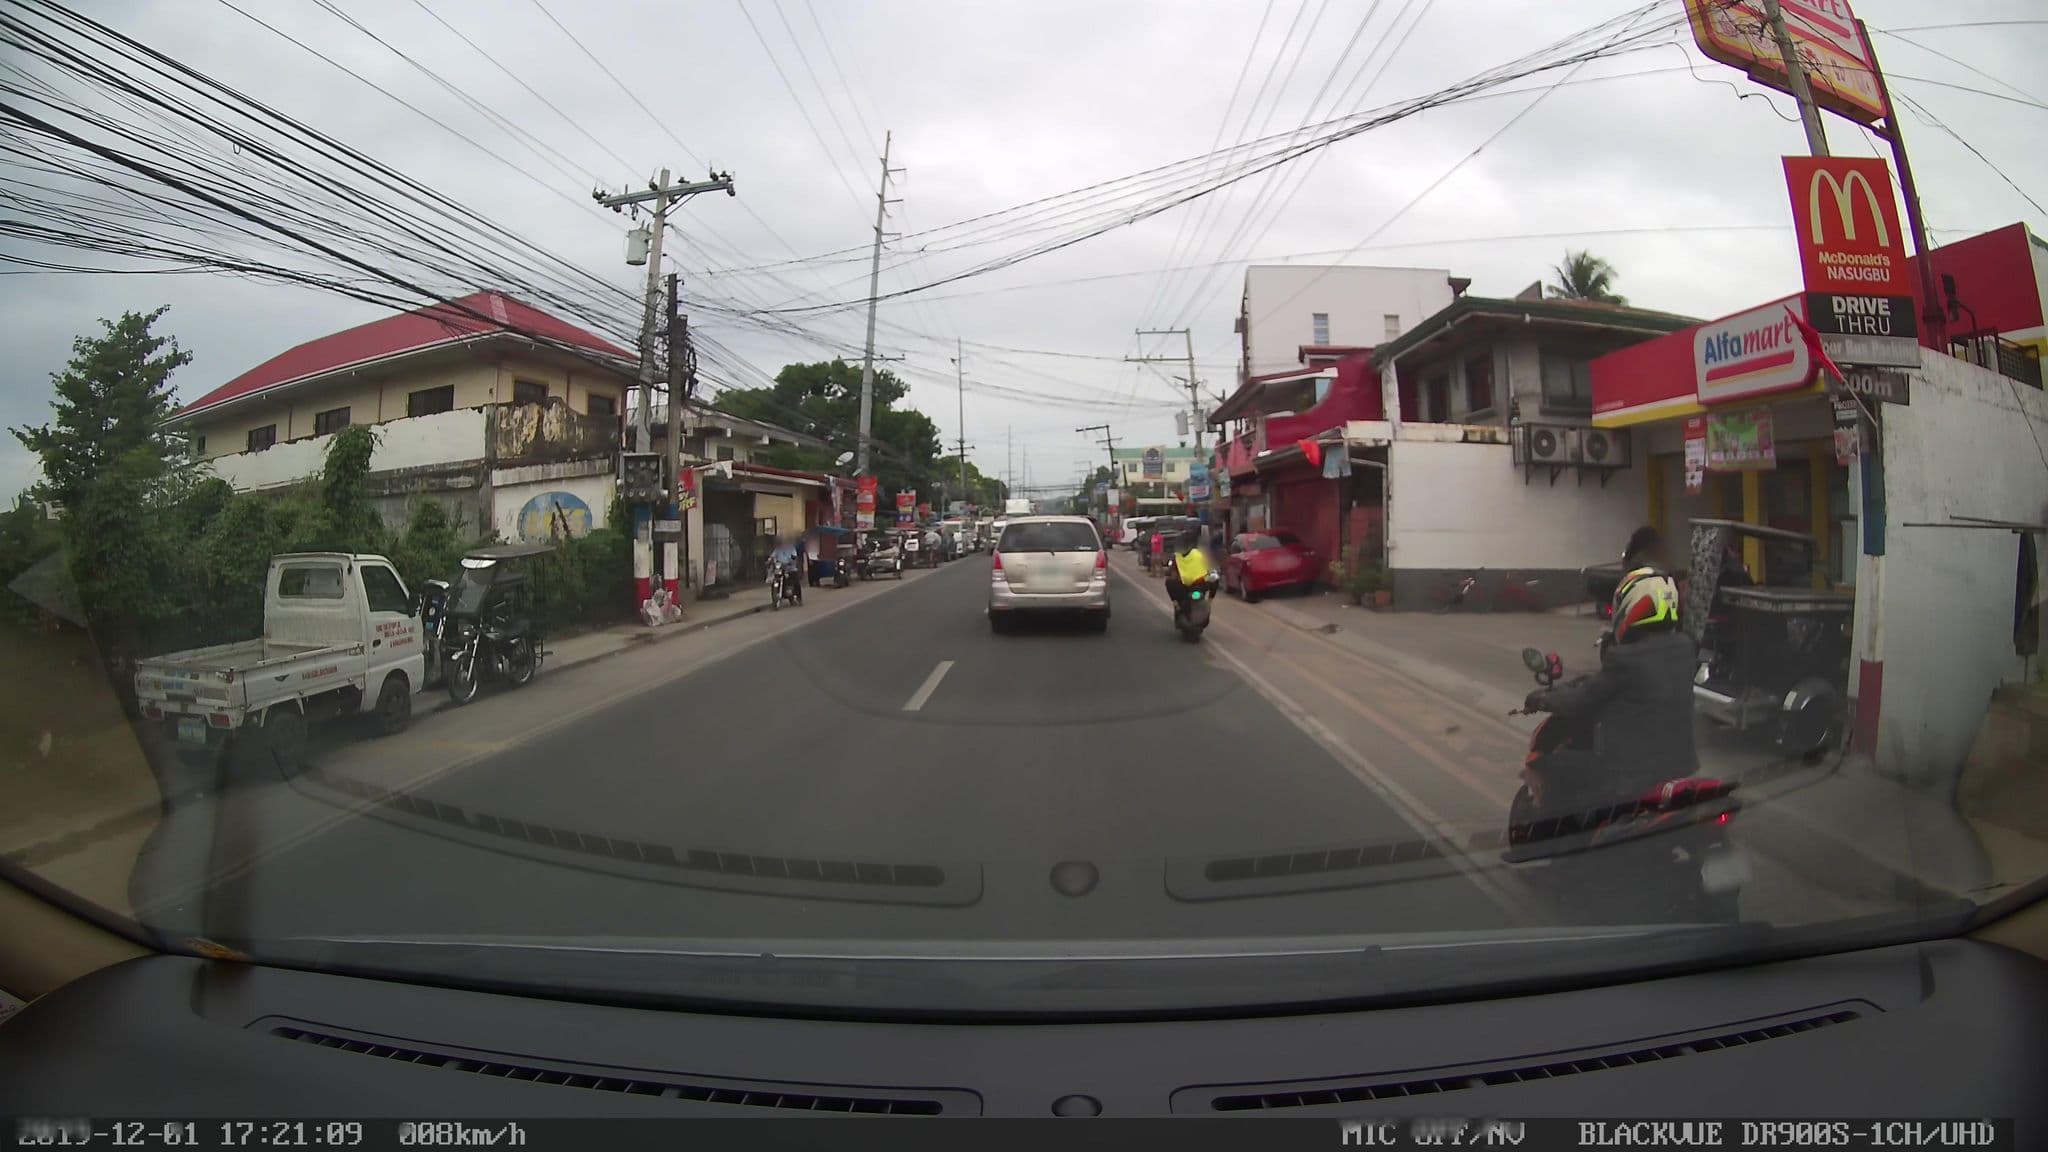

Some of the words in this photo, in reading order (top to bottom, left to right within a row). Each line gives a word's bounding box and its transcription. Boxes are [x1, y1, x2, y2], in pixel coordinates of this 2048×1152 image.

[1818, 251, 1890, 267] McDonald's
[1827, 266, 1890, 282] NASUGBU
[1832, 296, 1891, 316] DRIVE
[1835, 315, 1890, 334] THRU
[1704, 316, 1793, 364] Alfamart
[1822, 340, 1841, 354] our
